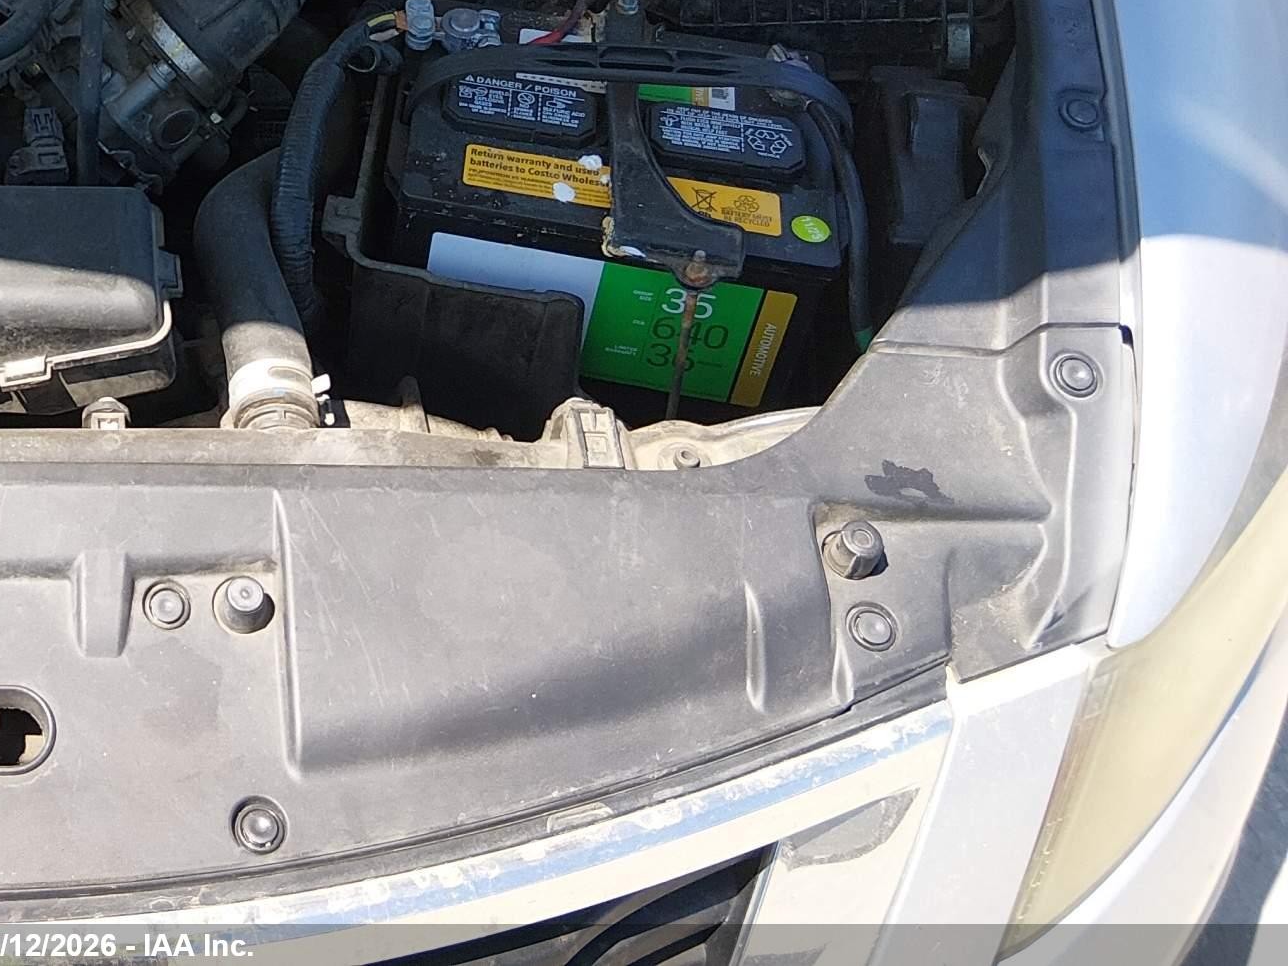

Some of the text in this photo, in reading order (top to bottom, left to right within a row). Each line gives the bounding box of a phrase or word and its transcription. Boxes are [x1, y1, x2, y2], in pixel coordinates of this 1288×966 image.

[477, 75, 523, 90] DANGER
[535, 85, 577, 98] POISON
[470, 157, 513, 172] batteries
[515, 165, 526, 174] to
[528, 166, 560, 180] Costco
[471, 147, 601, 176] Return warranty and used
[661, 287, 717, 319] 35
[651, 316, 729, 350] 640
[749, 323, 777, 377] AUTOMOTIVE
